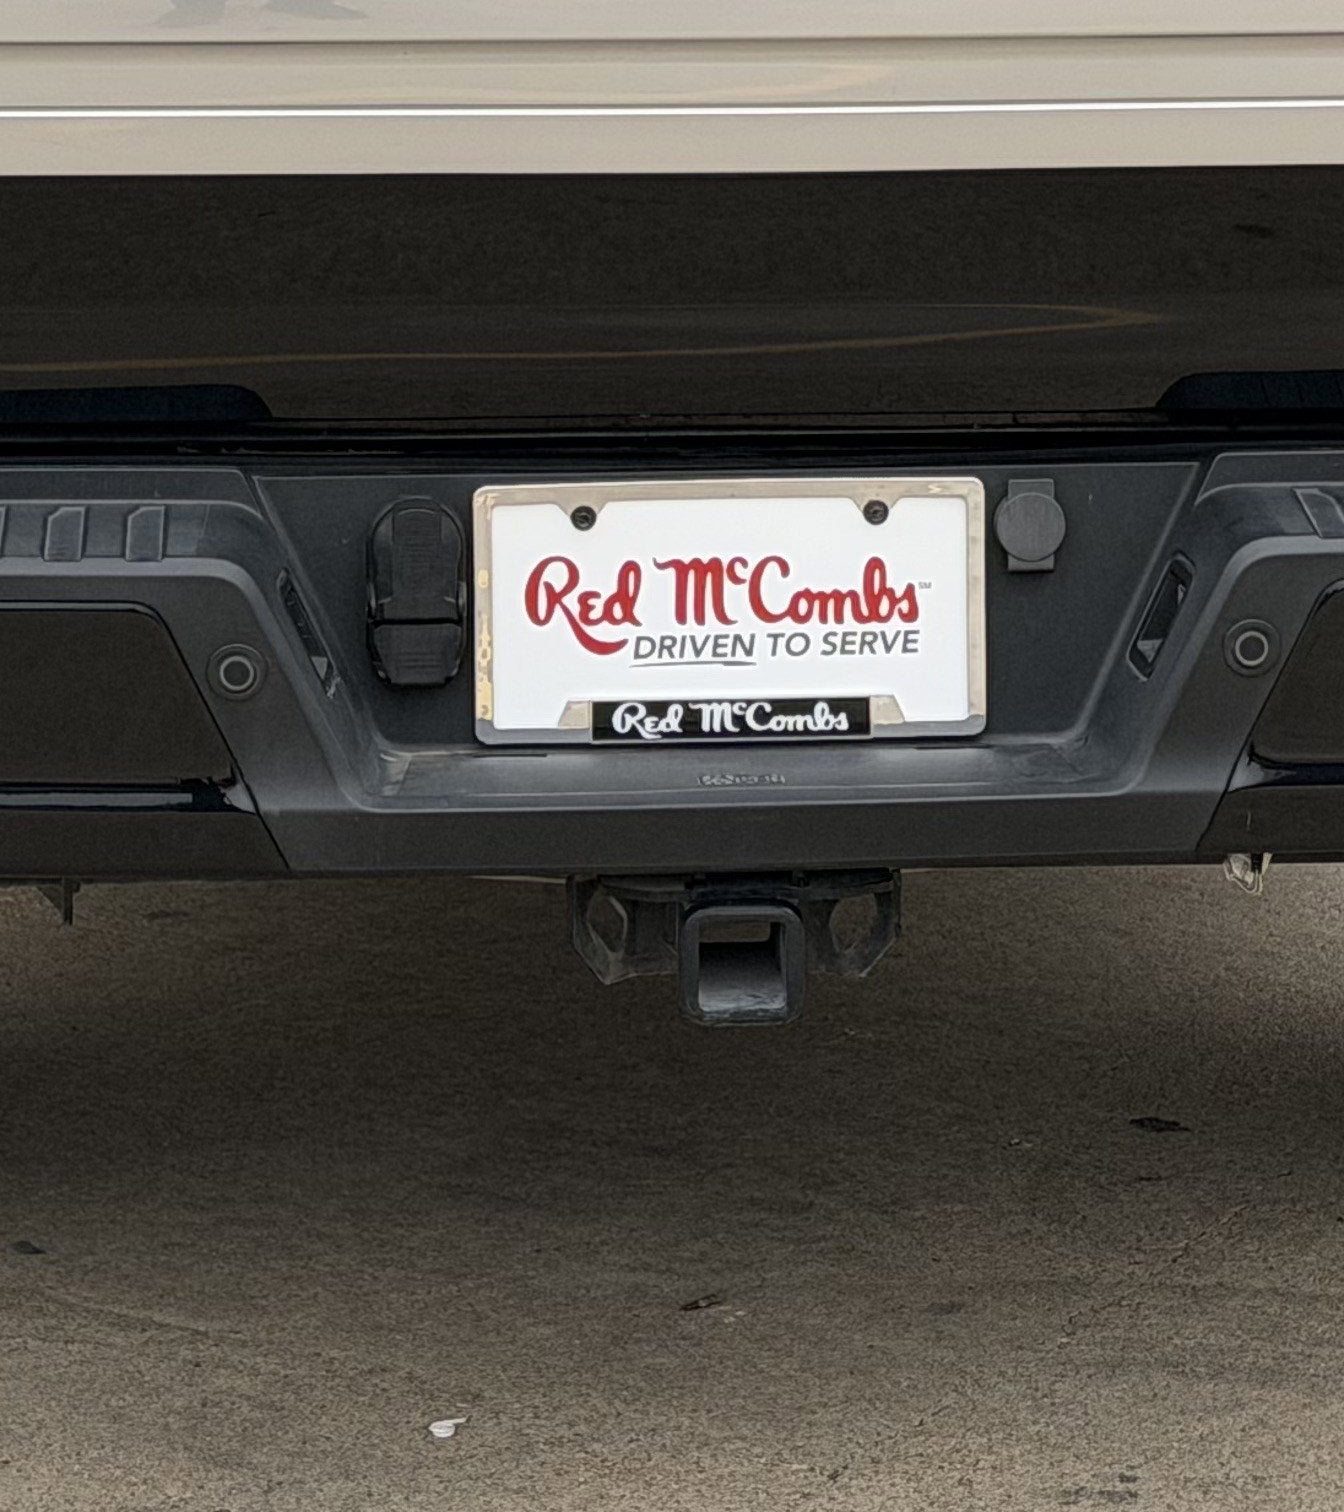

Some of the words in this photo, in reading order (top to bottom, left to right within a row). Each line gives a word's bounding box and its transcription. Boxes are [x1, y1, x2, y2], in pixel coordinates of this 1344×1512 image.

[524, 555, 643, 655] Red
[652, 555, 920, 626] McCombs
[632, 632, 756, 661] DRIVEN
[766, 632, 812, 658] TO
[819, 629, 921, 657] SERVE
[611, 701, 683, 740] Red
[689, 701, 850, 734] McCombs
